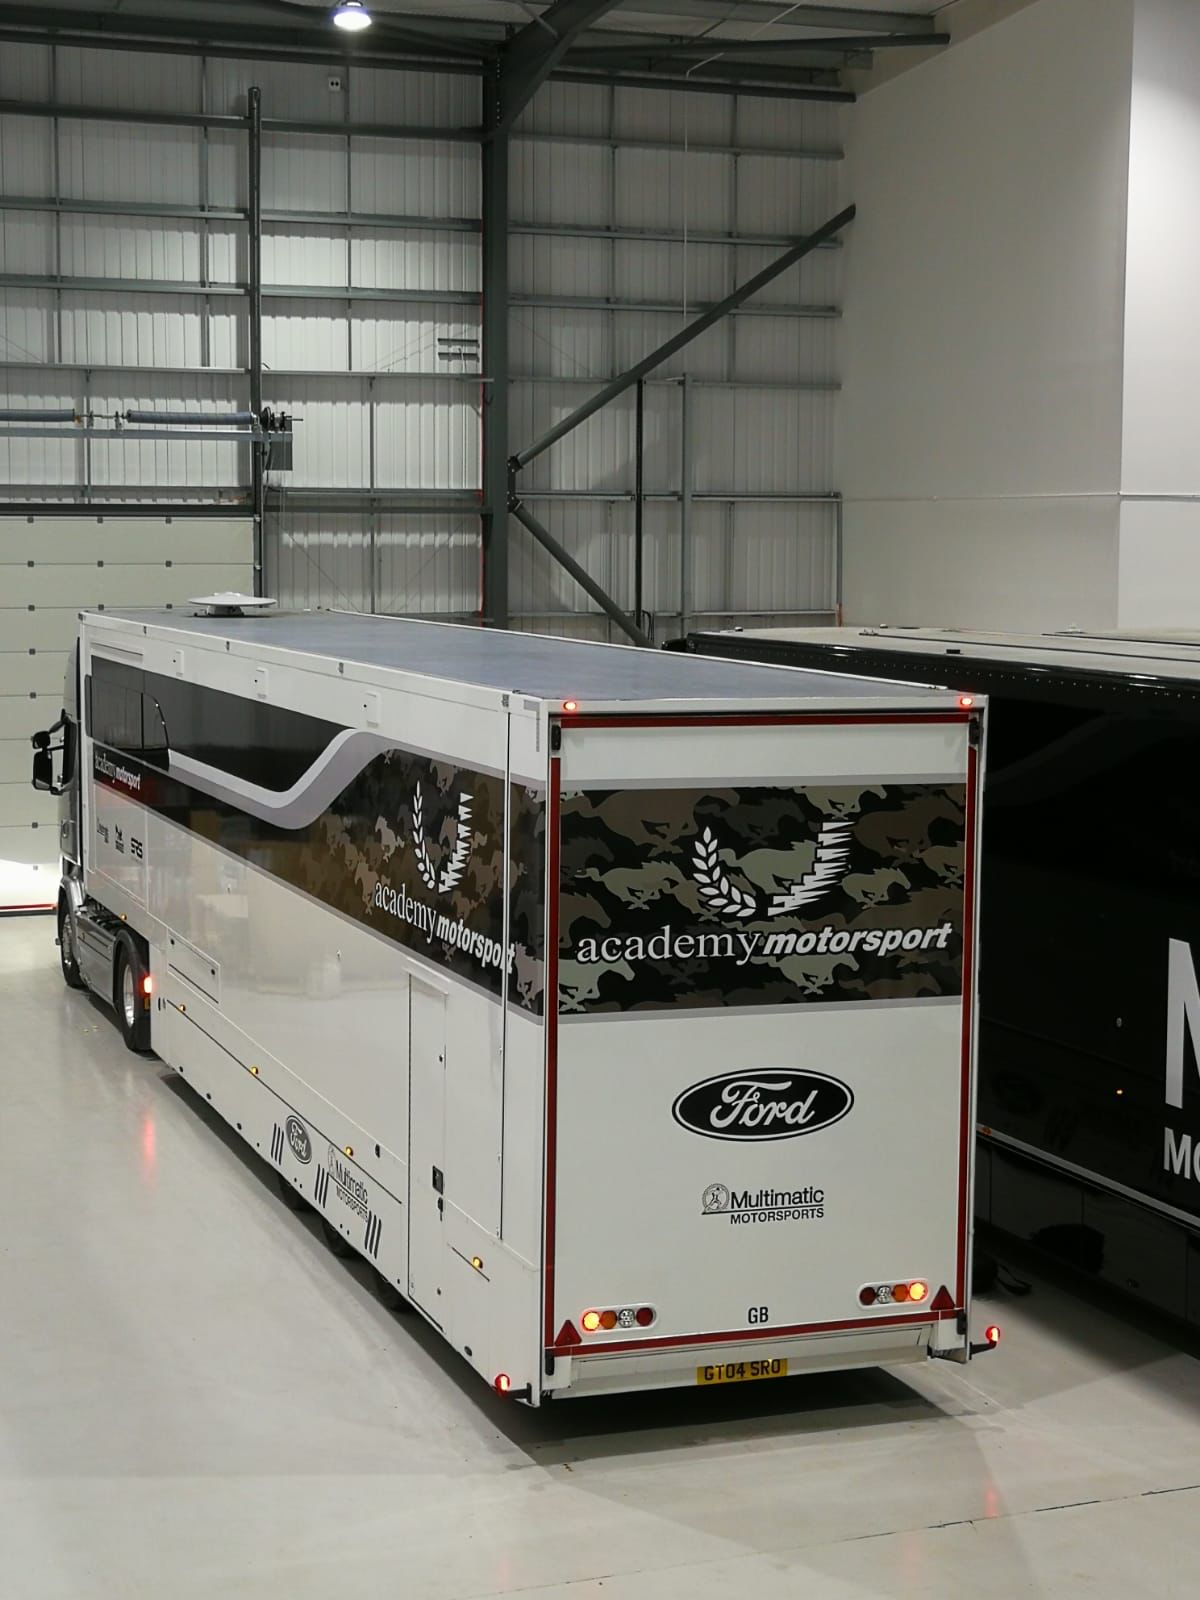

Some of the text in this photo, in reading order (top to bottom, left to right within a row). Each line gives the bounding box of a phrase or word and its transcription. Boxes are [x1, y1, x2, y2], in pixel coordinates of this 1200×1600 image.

[375, 882, 516, 974] academy motorsport
[575, 922, 953, 965] academy motorsport
[709, 1080, 818, 1129] Ford
[290, 1121, 307, 1158] Ford
[335, 1160, 368, 1205] Multimatic
[730, 1186, 824, 1210] Multimatic
[336, 1185, 369, 1223] MOTORSPORTS
[730, 1207, 824, 1225] MOTORSPORTS
[747, 1306, 769, 1324] GB
[704, 1362, 745, 1381] GT04
